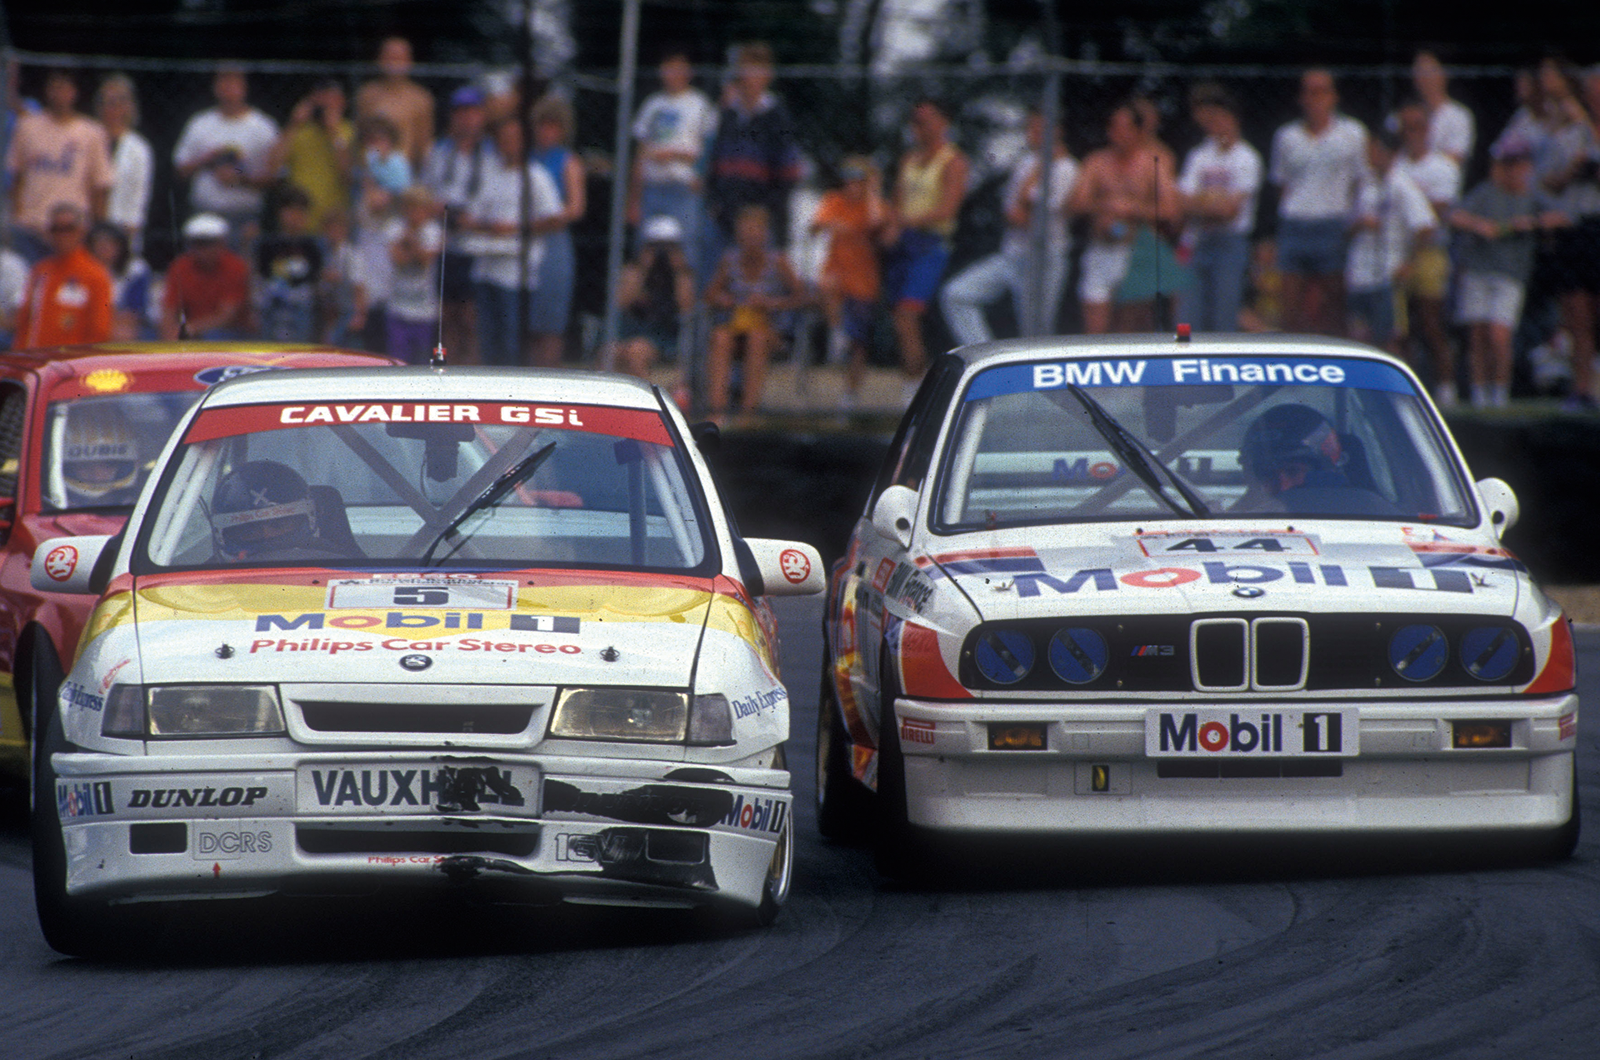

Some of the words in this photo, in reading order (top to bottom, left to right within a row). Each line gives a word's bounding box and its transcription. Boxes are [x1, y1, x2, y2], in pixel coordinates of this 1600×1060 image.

[1033, 360, 1148, 388] BMW
[1171, 359, 1346, 384] Finance
[280, 404, 481, 423] CAVALIER
[501, 405, 583, 426] GSi
[1165, 538, 1292, 552] 44
[1012, 561, 1349, 598] Mobil
[393, 586, 449, 605] 5
[254, 611, 484, 632] Mobil
[249, 638, 374, 655] Philips
[381, 638, 451, 651] Car
[457, 638, 582, 655] Stereo
[731, 695, 760, 719] Daily
[755, 687, 788, 710] Express
[1159, 713, 1283, 753] Mobil
[57, 783, 94, 817] Mobil
[127, 787, 268, 808] DUNLOP
[721, 794, 773, 832] Mobil
[199, 831, 272, 854] DCRS
[367, 855, 406, 867] Philips
[409, 855, 431, 864] Car
